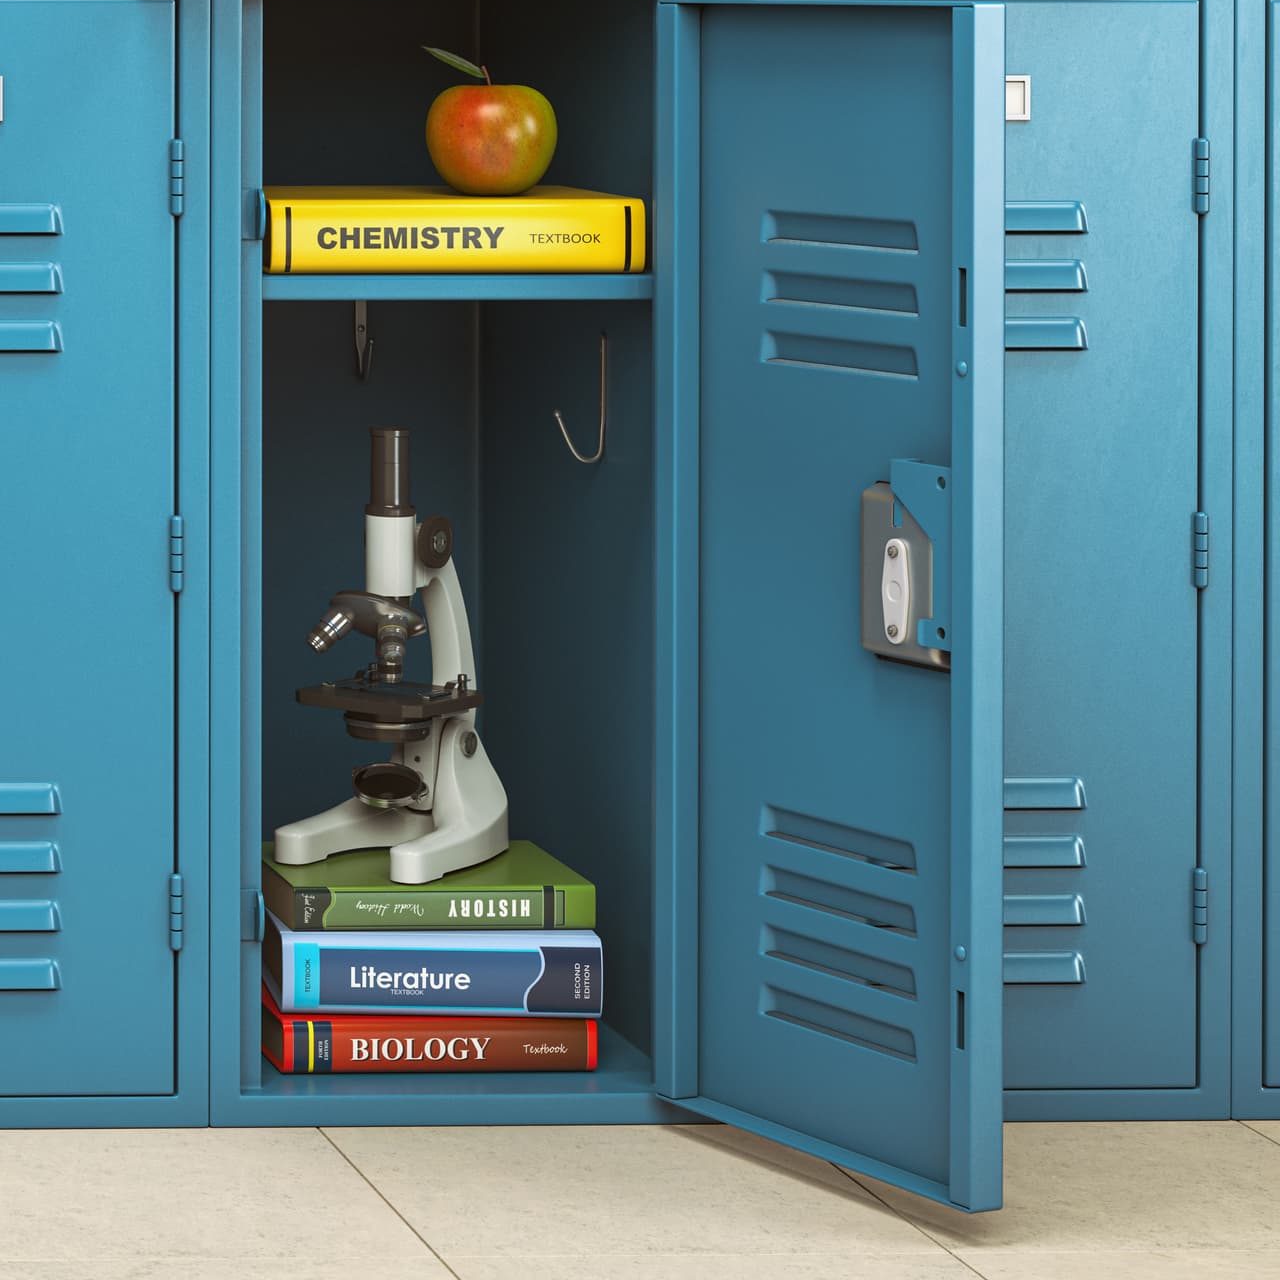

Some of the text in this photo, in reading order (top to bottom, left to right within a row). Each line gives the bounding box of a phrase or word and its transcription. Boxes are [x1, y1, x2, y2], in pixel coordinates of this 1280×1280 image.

[317, 226, 601, 249] CHEMISTRY TEXTBOOK
[355, 900, 425, 917] World History
[448, 899, 531, 918] HISTORY
[350, 966, 471, 990] Literature
[583, 964, 591, 999] EDITION
[349, 1037, 491, 1061] BIOLOGY
[523, 1043, 568, 1054] Textbook
